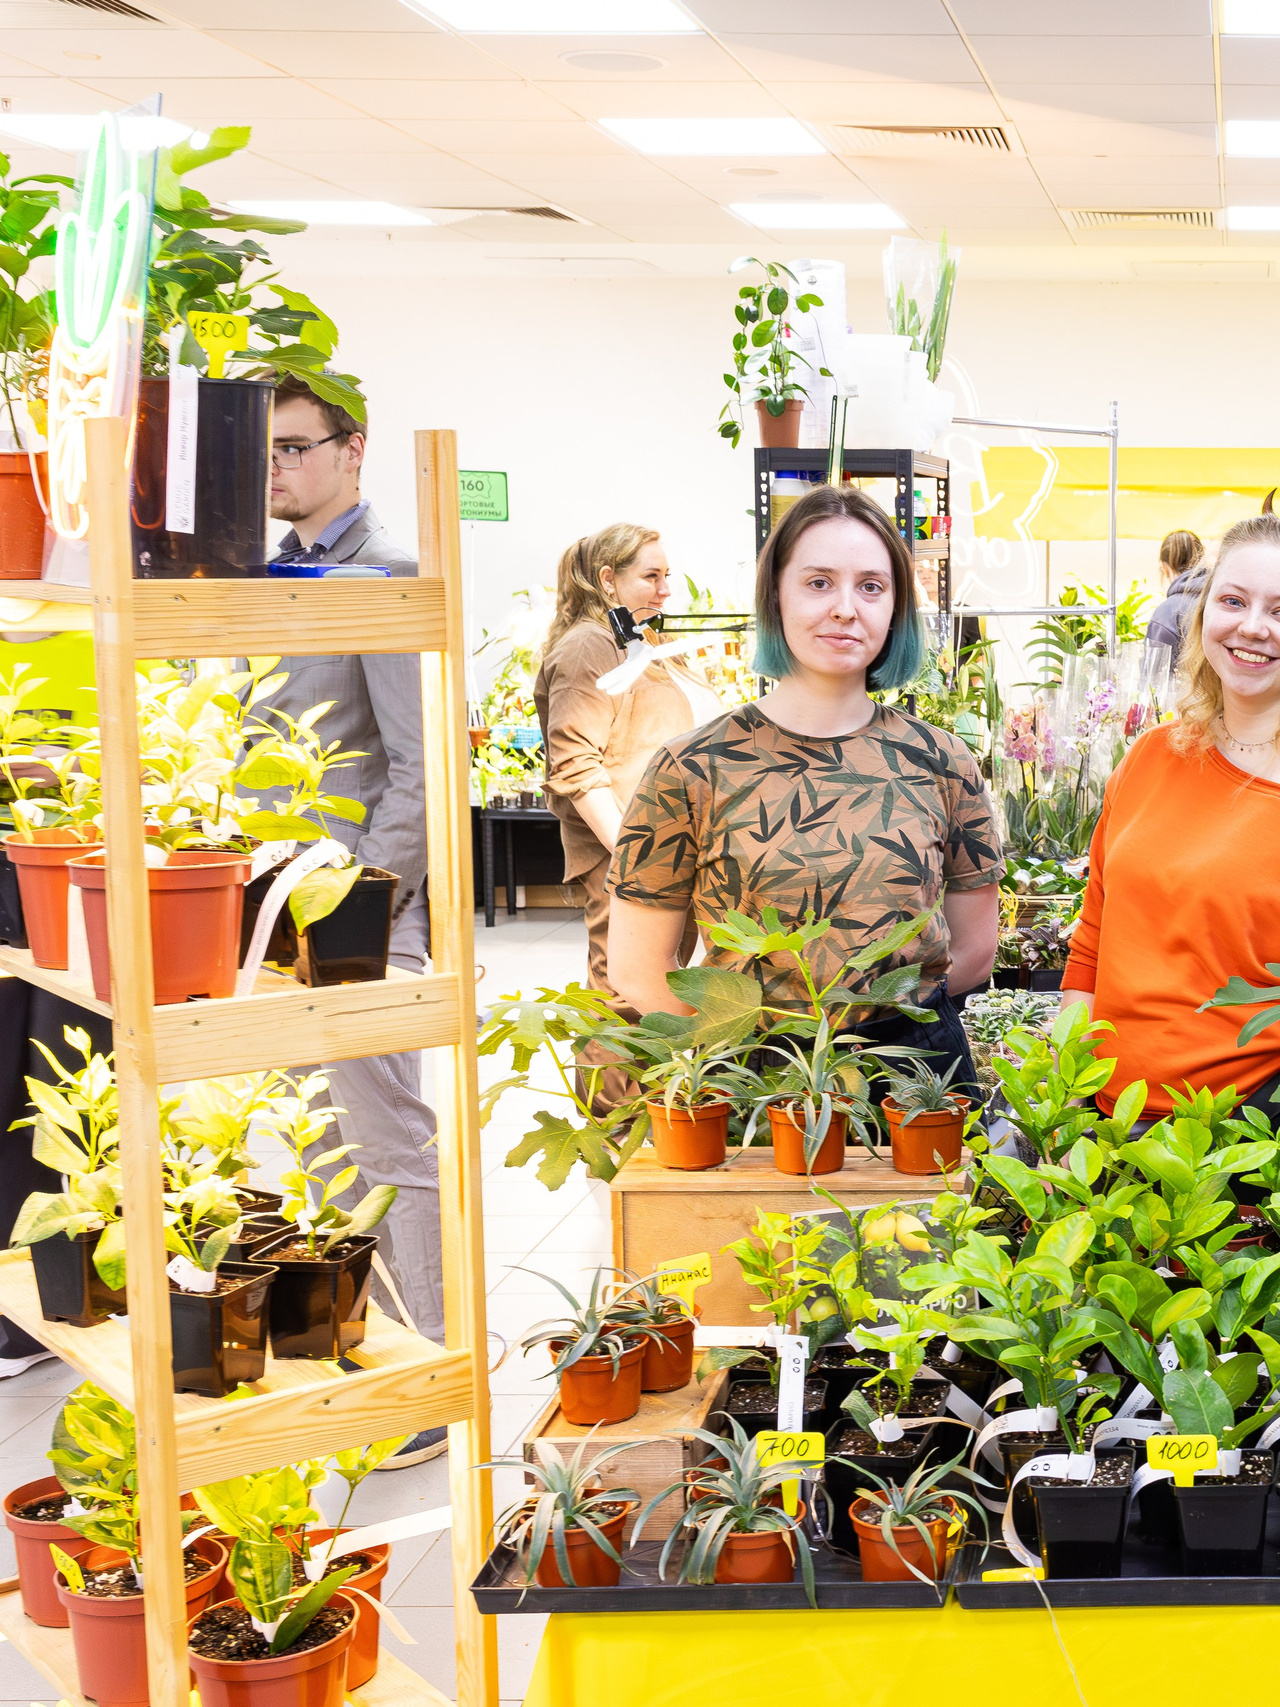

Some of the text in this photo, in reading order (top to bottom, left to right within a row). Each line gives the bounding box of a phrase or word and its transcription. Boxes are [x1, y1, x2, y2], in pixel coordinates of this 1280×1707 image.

[193, 318, 237, 338] 1500
[460, 480, 484, 491] 160
[763, 1437, 810, 1457] 700
[1158, 1441, 1210, 1460] 1000
